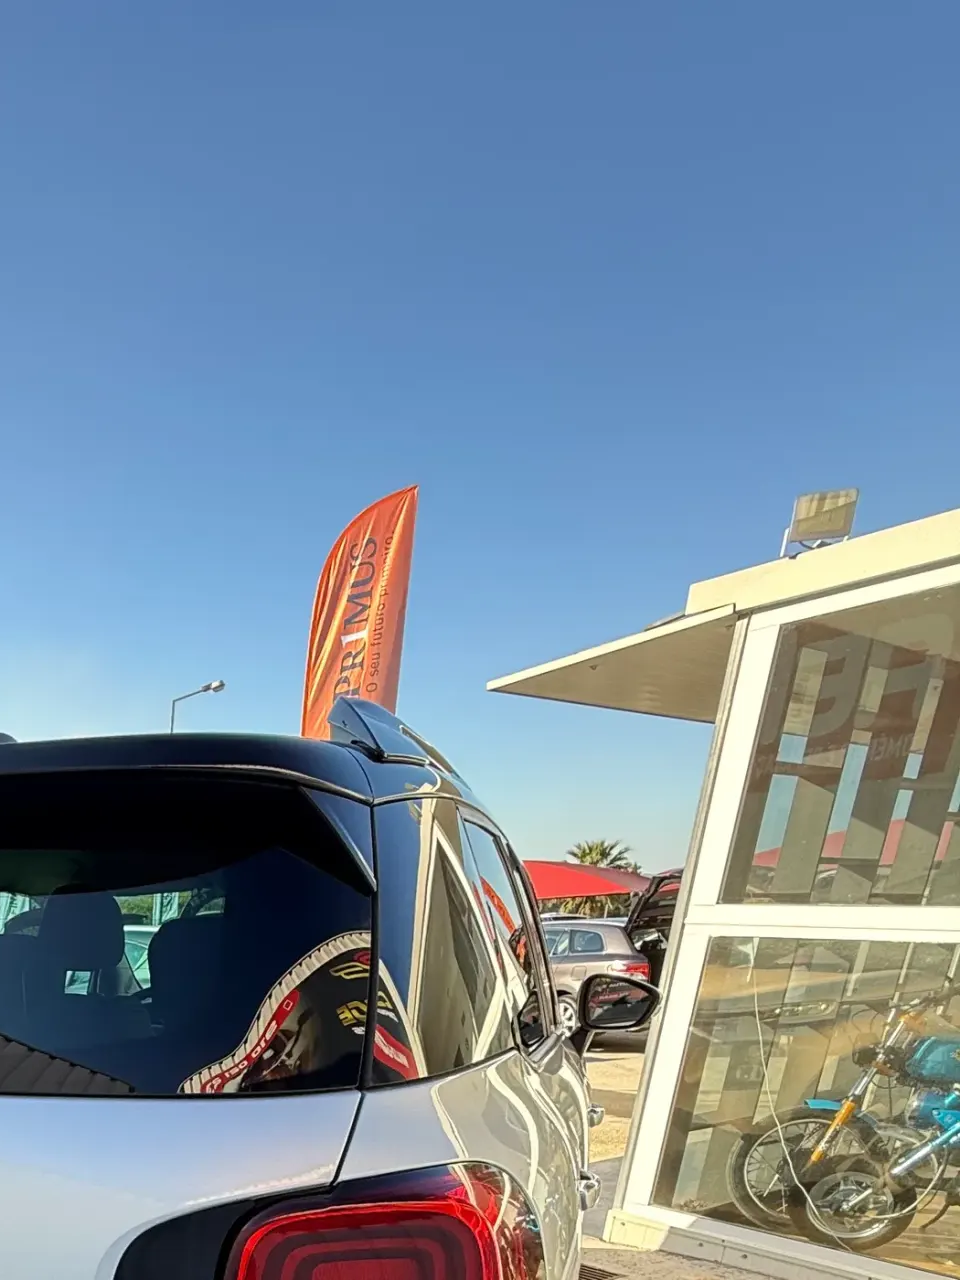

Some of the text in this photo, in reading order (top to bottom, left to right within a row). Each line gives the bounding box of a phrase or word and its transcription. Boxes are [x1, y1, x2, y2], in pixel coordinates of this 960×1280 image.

[370, 602, 386, 649] futuro
[369, 653, 381, 678] seu
[365, 682, 378, 693] O
